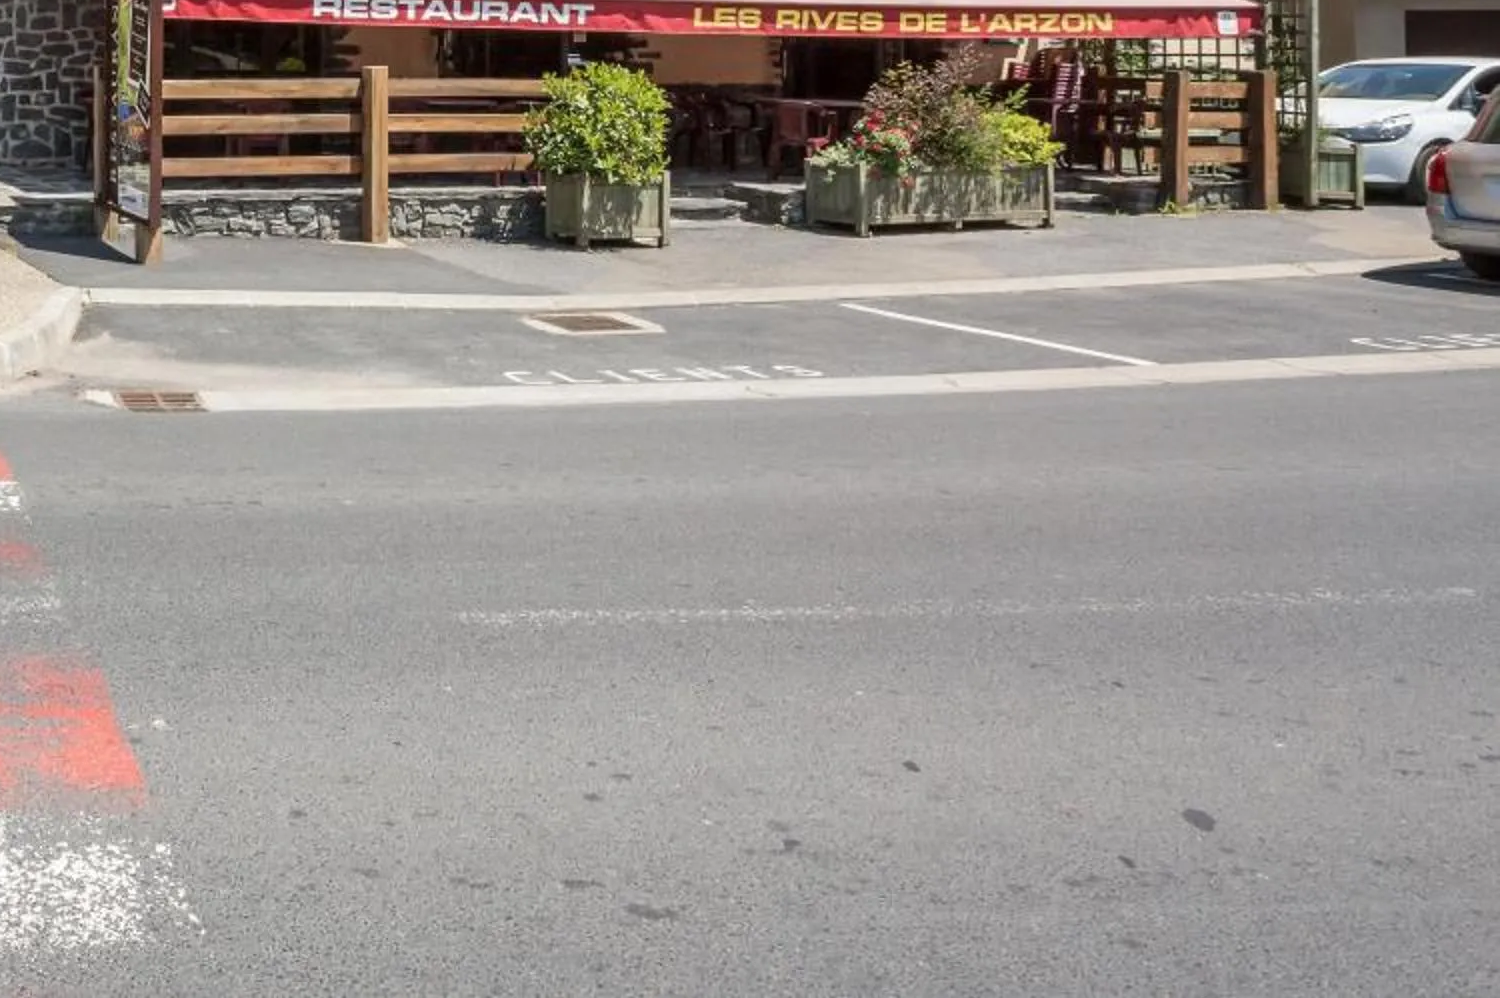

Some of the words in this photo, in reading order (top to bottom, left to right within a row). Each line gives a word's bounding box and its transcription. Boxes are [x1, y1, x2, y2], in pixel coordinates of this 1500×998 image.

[693, 7, 763, 30] LES
[775, 9, 885, 32] RIVES
[899, 10, 948, 34] DE
[960, 12, 1113, 35] L'ARZON
[502, 365, 824, 385] CLIENTS
